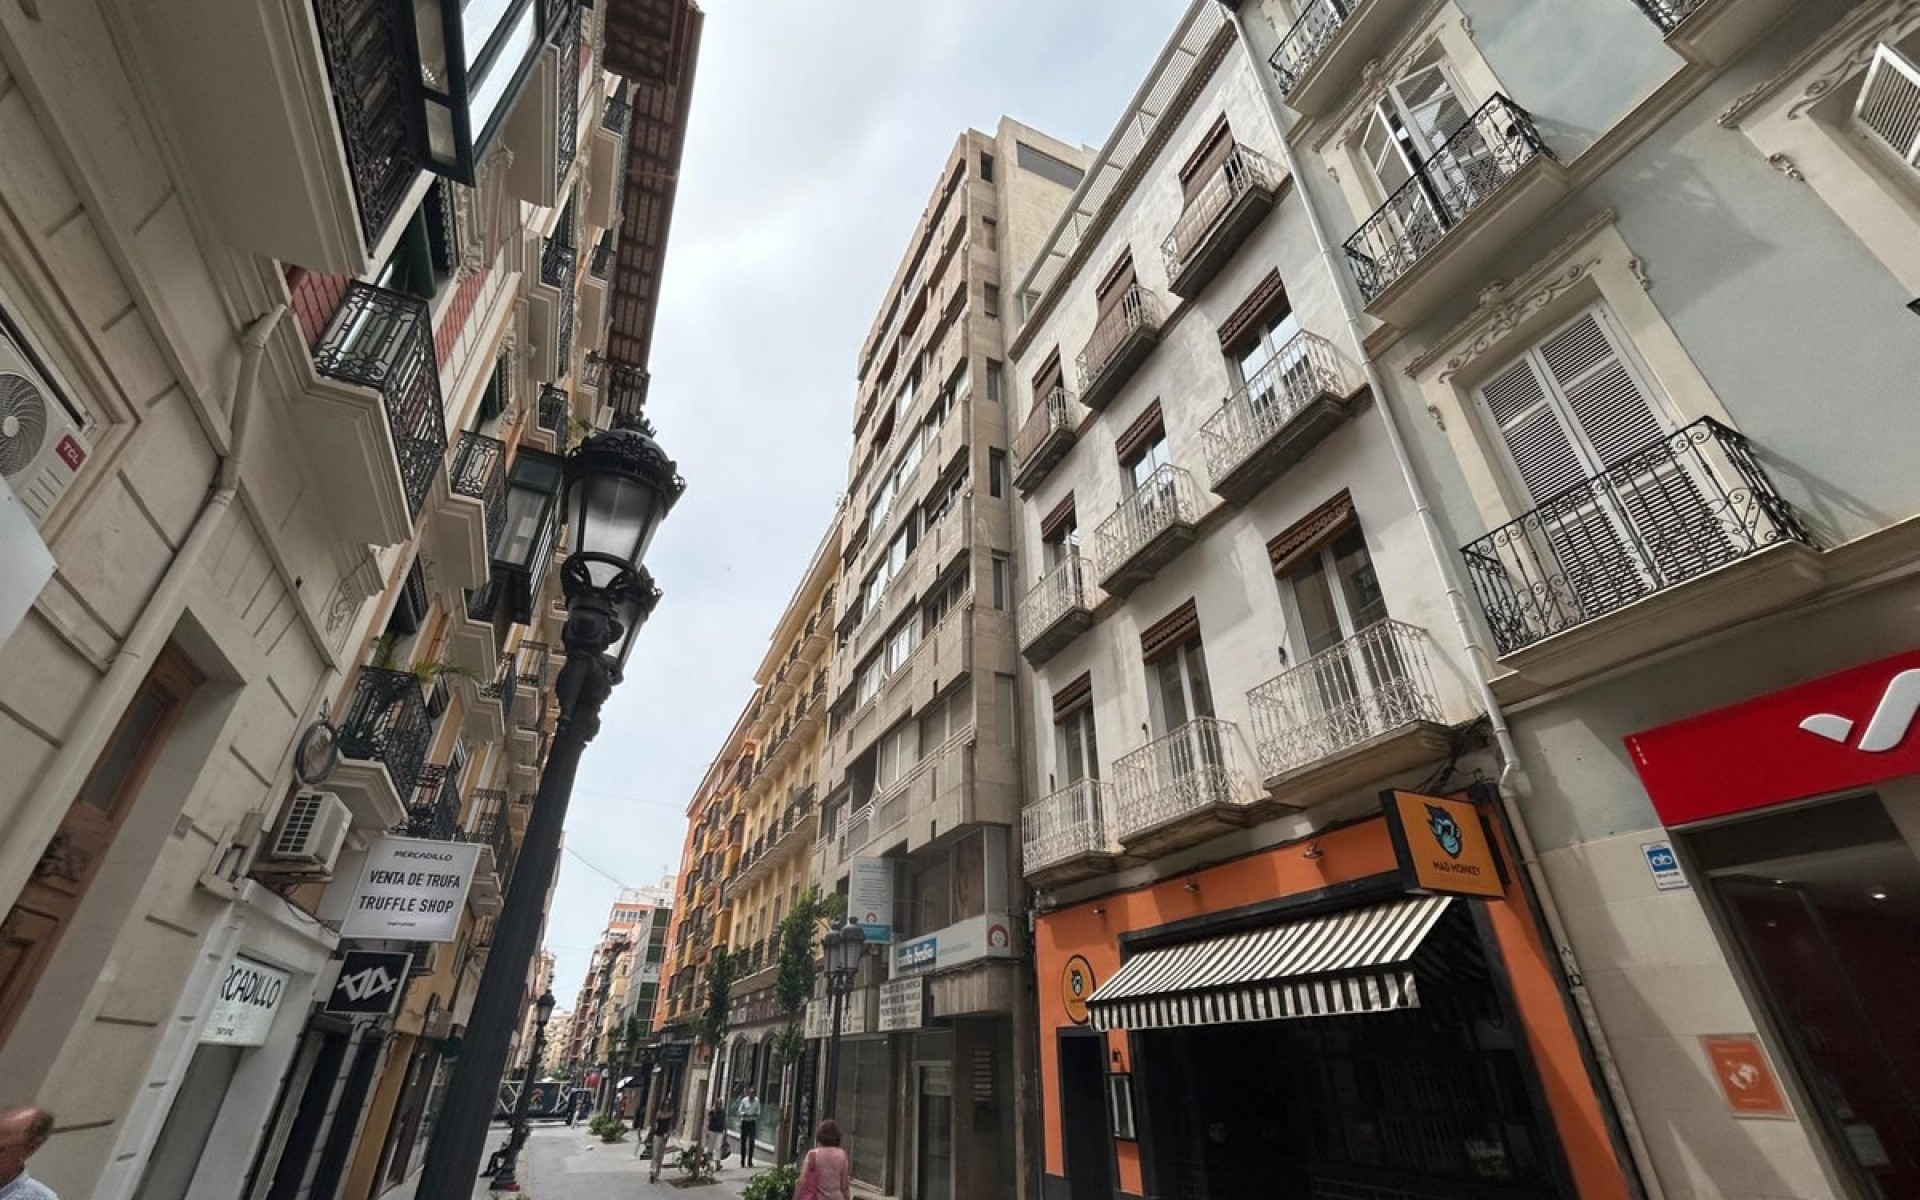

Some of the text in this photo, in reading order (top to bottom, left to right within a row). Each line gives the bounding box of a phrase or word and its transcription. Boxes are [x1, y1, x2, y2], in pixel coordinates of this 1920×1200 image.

[63, 441, 80, 465] TCL
[394, 850, 454, 861] MERCADILLO
[1433, 861, 1481, 876] MAD MONKEY
[369, 870, 461, 888] VENTA DE TRUFA
[359, 895, 454, 913] TRUFFLE SHOP
